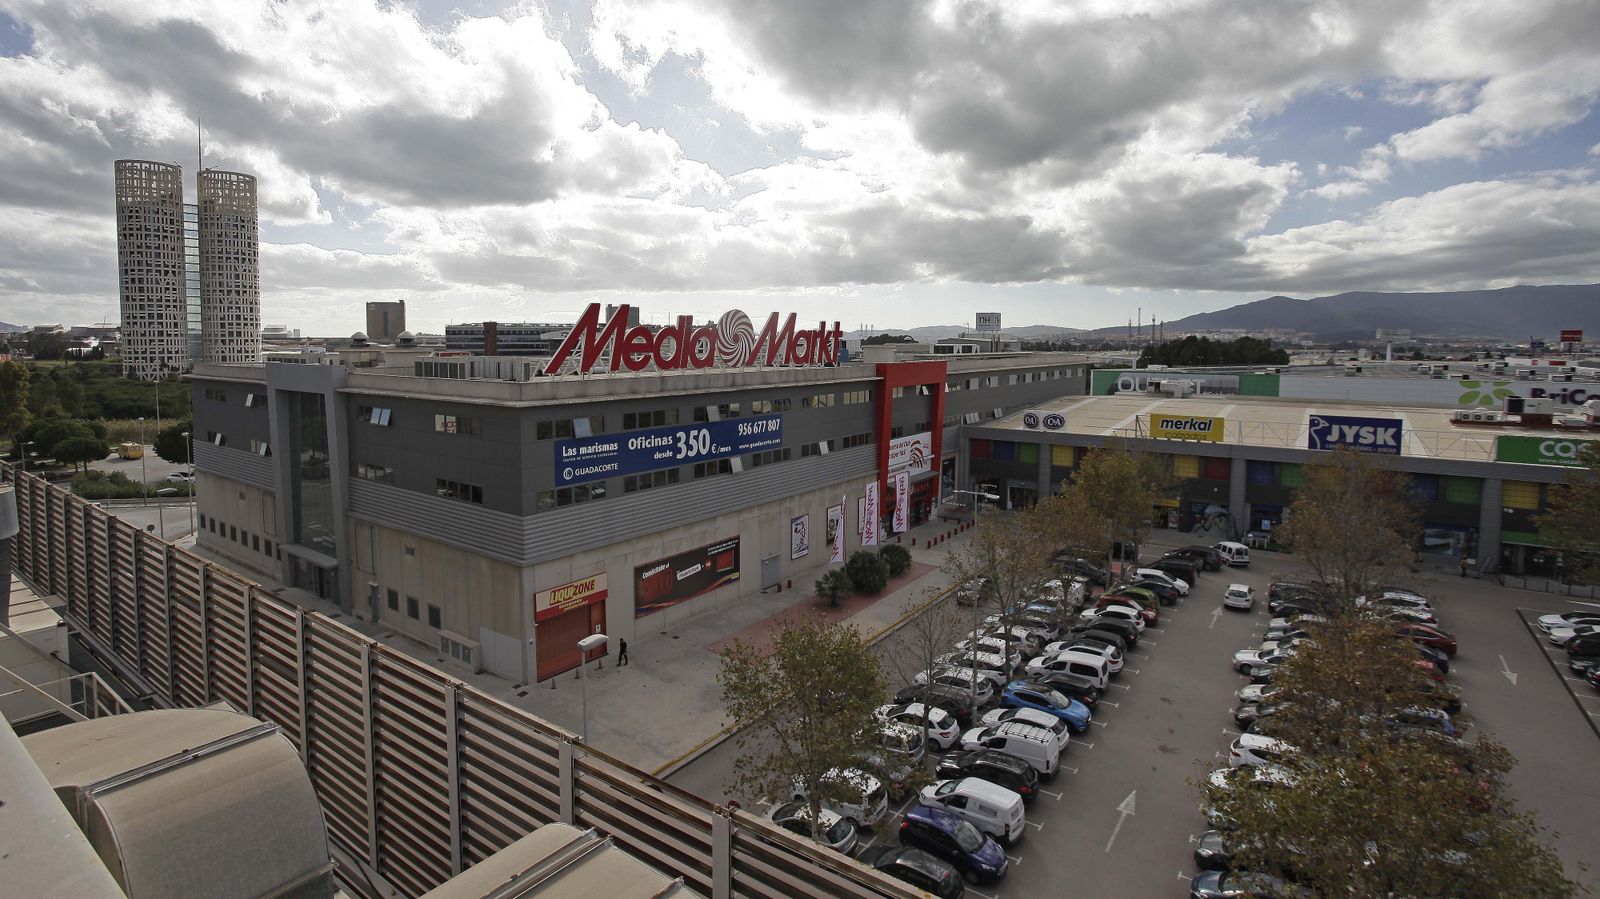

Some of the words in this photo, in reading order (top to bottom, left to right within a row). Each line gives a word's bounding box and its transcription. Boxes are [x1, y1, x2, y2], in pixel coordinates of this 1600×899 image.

[544, 302, 718, 374] Media
[745, 311, 844, 368] Markt
[1117, 376, 1206, 394] OUT
[738, 422, 752, 437] 956
[753, 420, 767, 434] 677
[767, 417, 781, 432] 807
[1160, 418, 1213, 432] merkal
[628, 434, 673, 450] Oficinas
[1165, 431, 1208, 441] calzados
[1326, 424, 1398, 446] JYSK
[562, 445, 577, 457] Las
[579, 442, 619, 455] marismas
[653, 450, 673, 460] desde
[676, 428, 711, 460] 350
[574, 463, 619, 476] GUADACORTE
